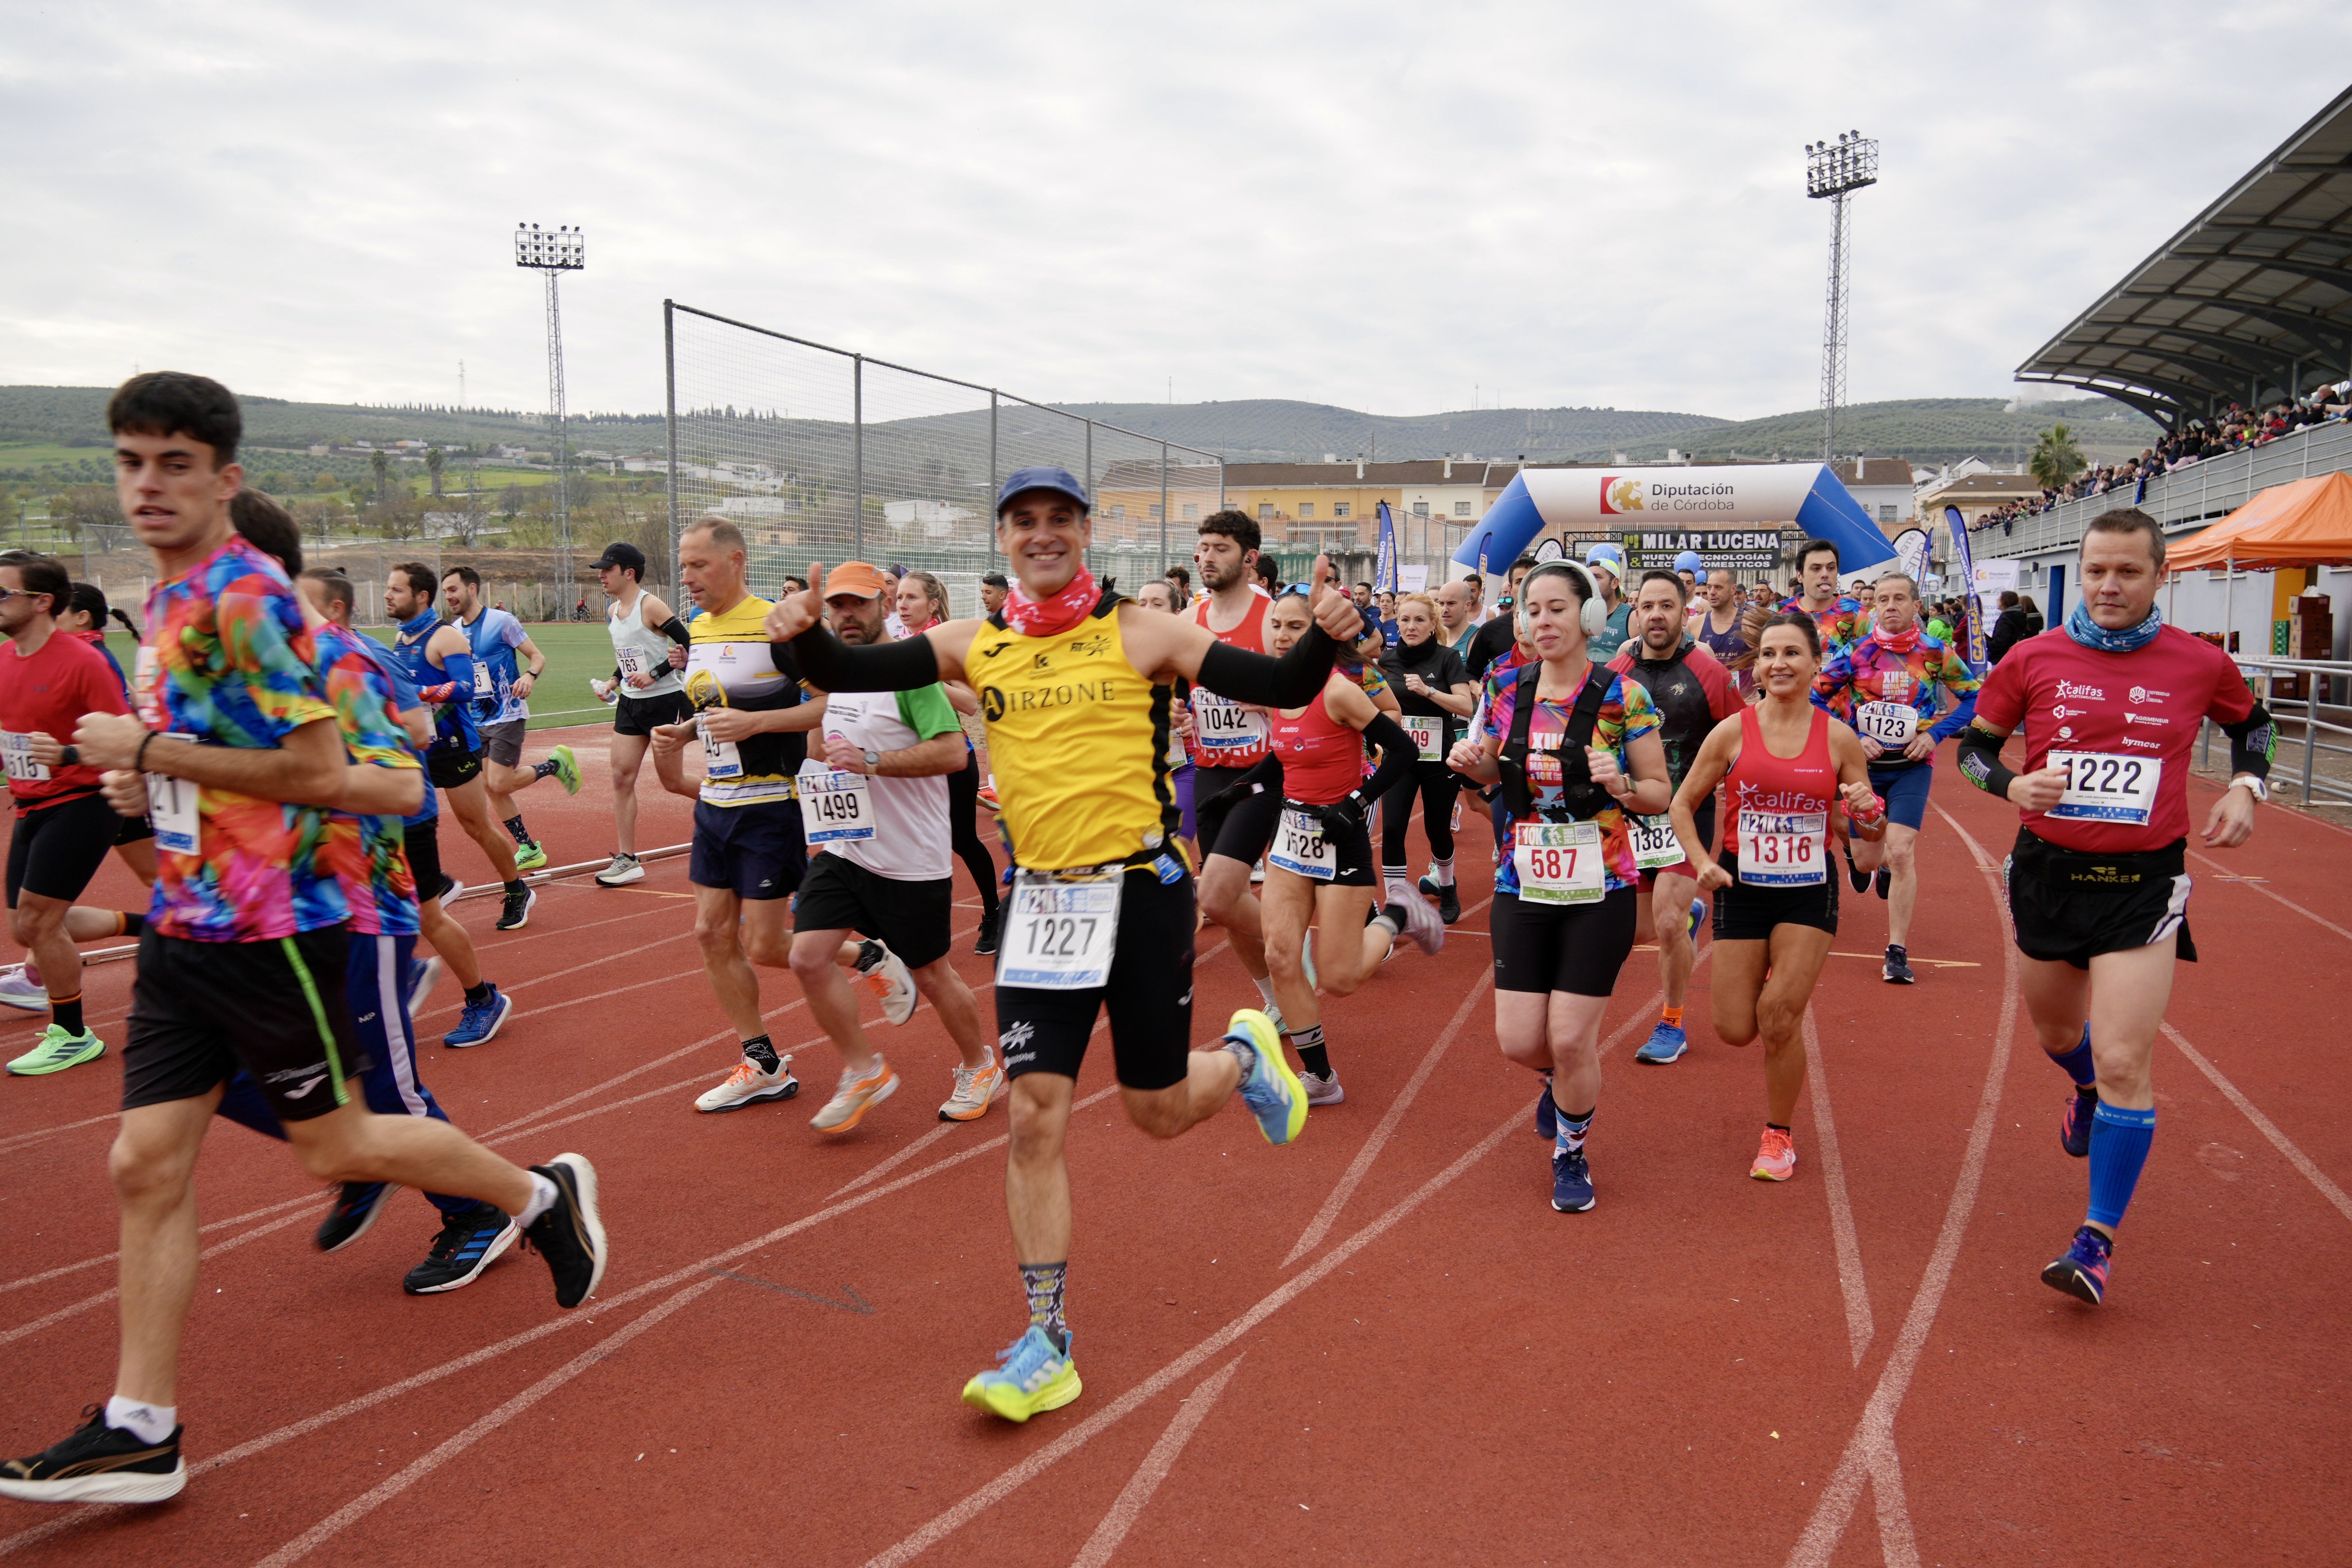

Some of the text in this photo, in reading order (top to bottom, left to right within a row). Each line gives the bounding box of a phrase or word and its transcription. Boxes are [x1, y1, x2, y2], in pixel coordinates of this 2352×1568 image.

[1652, 484, 1733, 498] Diputación
[1652, 499, 1734, 510] de Córdoba
[1643, 533, 1779, 549] MILAR LUCENA
[1630, 557, 1641, 567] &
[1971, 613, 1983, 661] CASH
[621, 659, 638, 673] 763
[1883, 671, 1899, 683] XII
[983, 681, 1116, 717] AIRZONE
[2066, 685, 2102, 697] califas
[1203, 707, 1247, 730] 1042
[1865, 716, 1905, 738] 1123
[2135, 716, 2169, 724] AGRIMENSUR
[1531, 732, 1558, 750] XII
[2121, 737, 2161, 749] hymcor
[1529, 762, 1561, 771] MARAT
[1535, 771, 1552, 780] 10K
[2061, 758, 2142, 795] 1222
[811, 793, 858, 821] 1499
[1754, 791, 1826, 812] califas
[1750, 814, 1777, 833] 21K
[1286, 828, 1324, 859] 1528
[1522, 826, 1544, 846] 10K
[1633, 827, 1675, 852] 1382
[1750, 835, 1811, 863] 1316
[1532, 849, 1577, 879] 587
[1026, 918, 1097, 956] 1227
